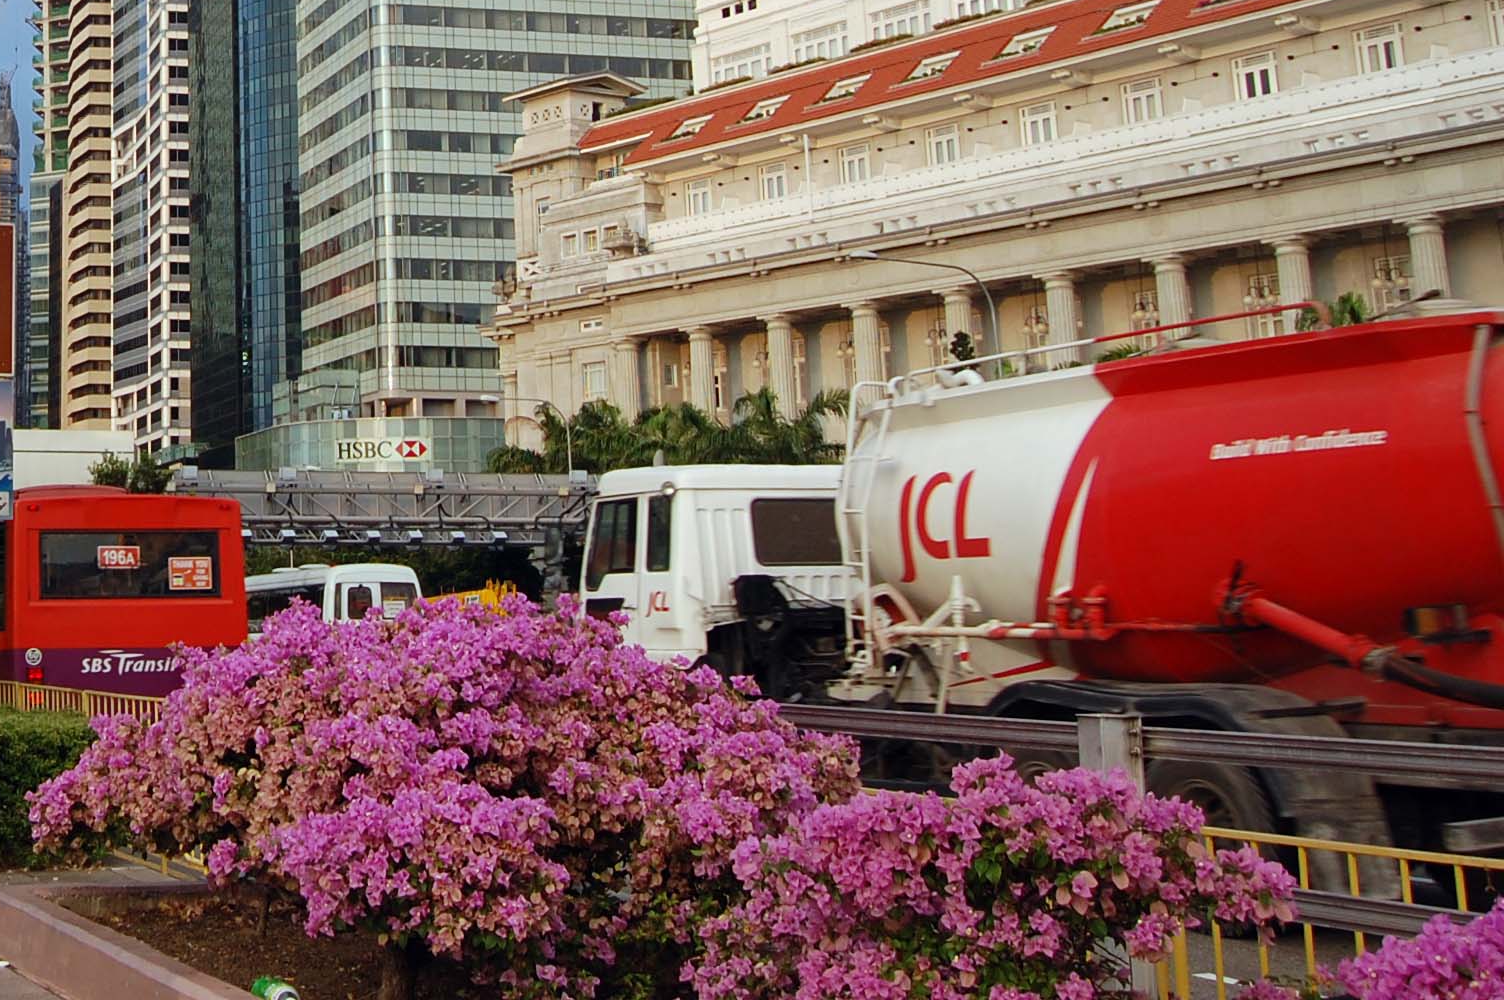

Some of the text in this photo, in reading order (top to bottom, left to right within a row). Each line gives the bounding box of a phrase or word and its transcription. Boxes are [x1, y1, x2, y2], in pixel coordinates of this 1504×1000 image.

[337, 441, 392, 459] HSBC
[1294, 429, 1388, 452] Confidence
[900, 468, 992, 583] JCL
[103, 550, 135, 565] 196A
[646, 591, 670, 617] JCL
[81, 658, 112, 673] SBS
